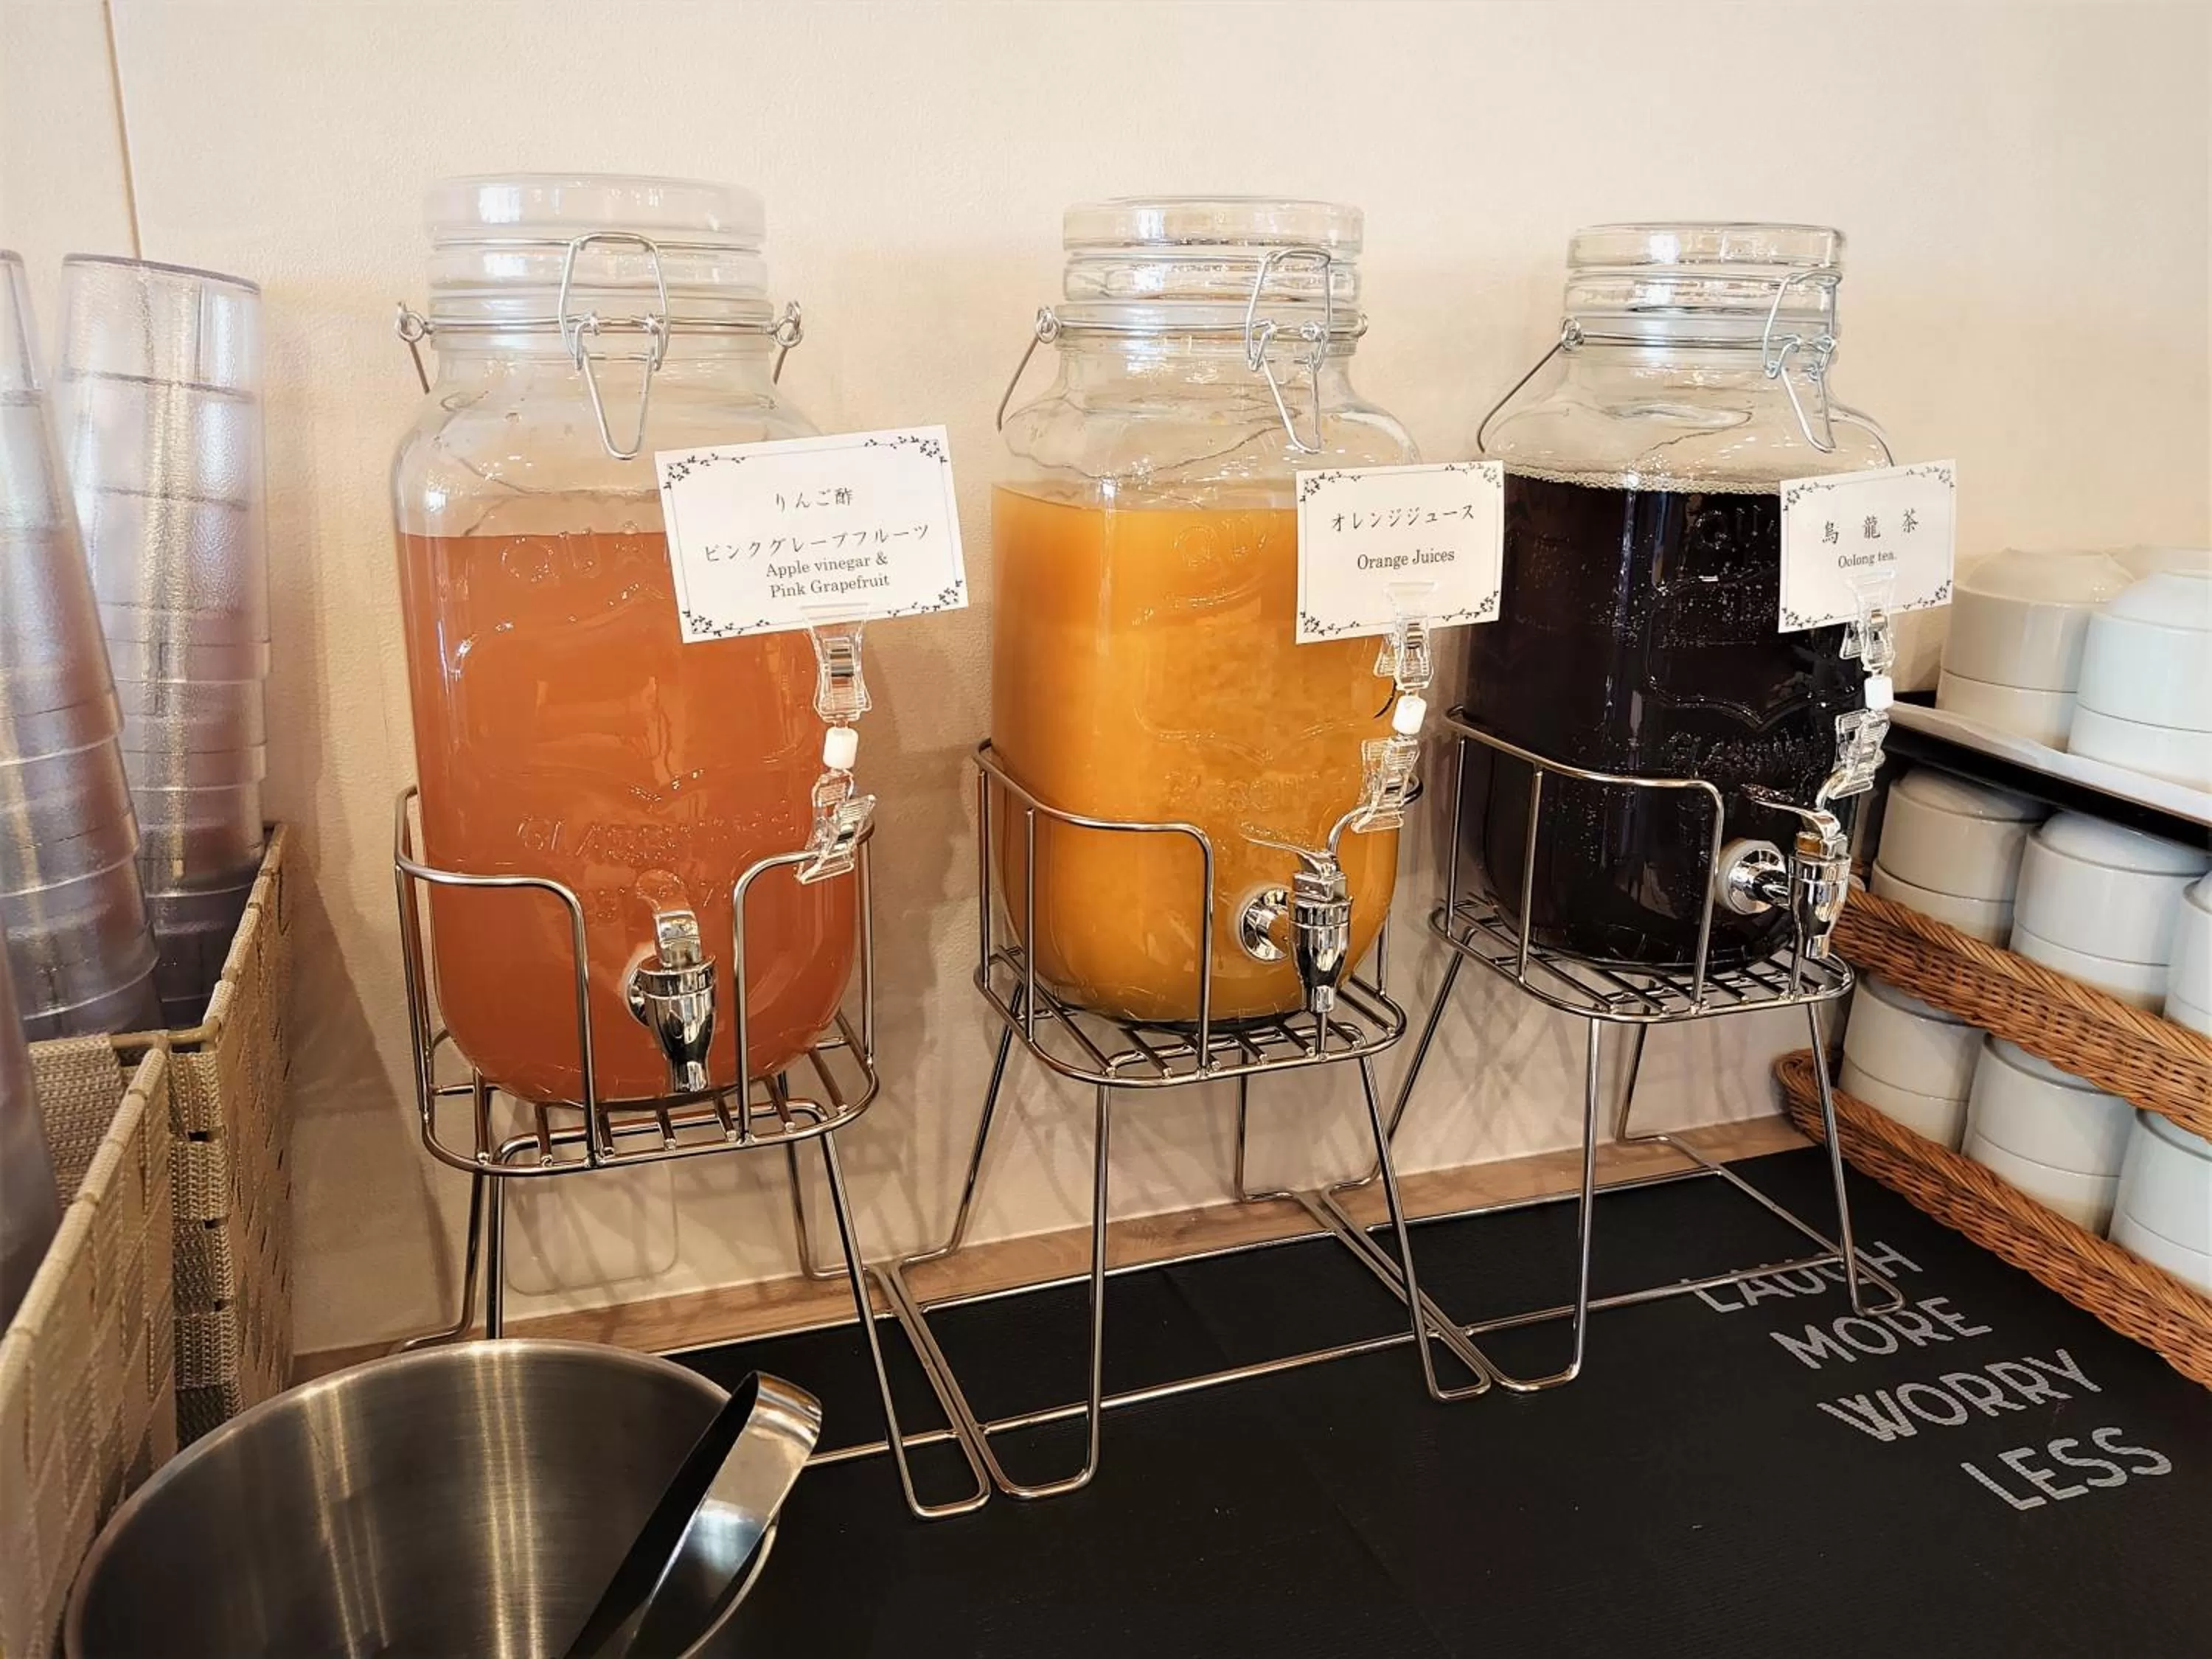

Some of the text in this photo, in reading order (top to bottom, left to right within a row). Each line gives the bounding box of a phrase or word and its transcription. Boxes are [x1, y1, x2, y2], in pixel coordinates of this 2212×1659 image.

[774, 487, 854, 512] りんご酢
[1331, 504, 1475, 532] オレンジジュース
[766, 550, 888, 579] Apple vinegar &
[1357, 548, 1455, 570] Orange Juices
[1838, 554, 1876, 568] Oolong
[769, 572, 890, 599] Pink Grapefruit
[1770, 1296, 1993, 1370] MORE
[1816, 1349, 2103, 1442] WORRY
[1960, 1427, 2173, 1511] LESS
